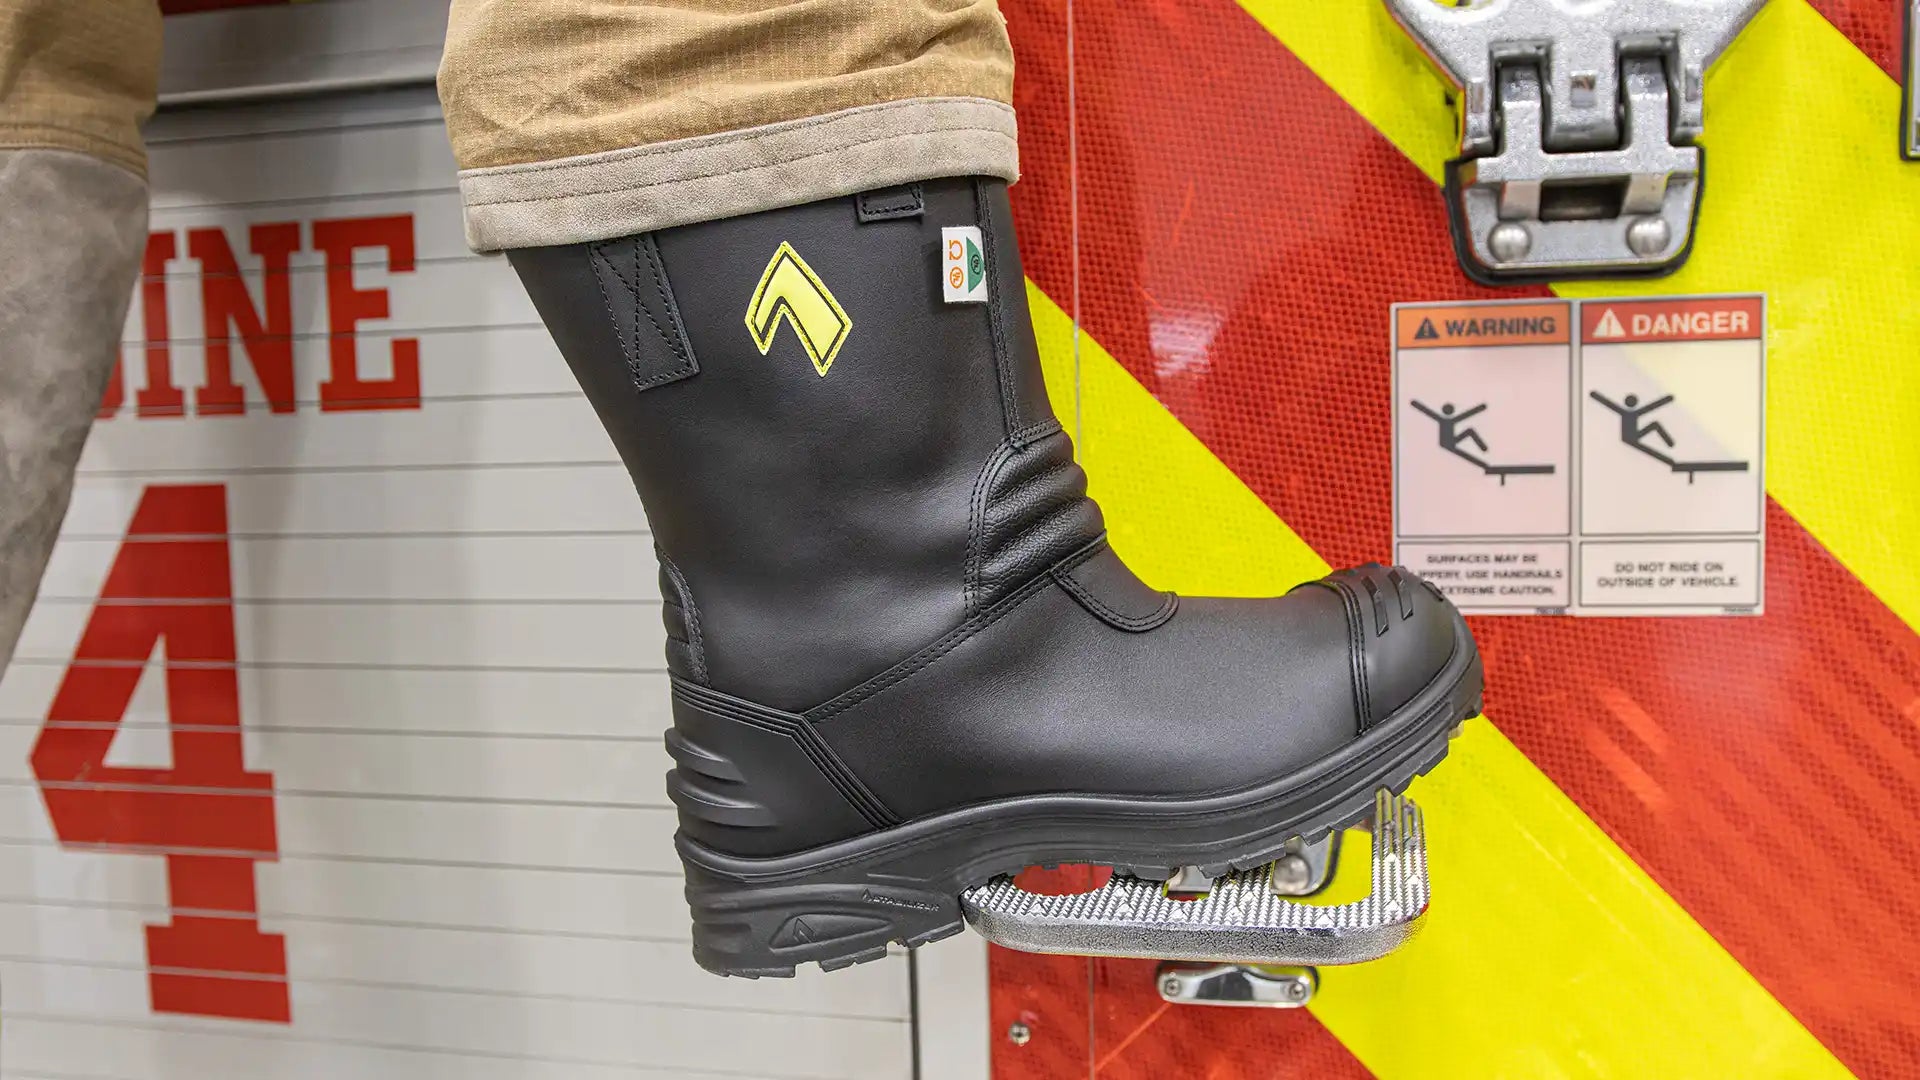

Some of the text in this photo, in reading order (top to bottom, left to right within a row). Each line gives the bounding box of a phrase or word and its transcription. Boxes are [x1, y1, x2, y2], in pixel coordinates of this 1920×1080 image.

[95, 213, 421, 420] INE
[1632, 310, 1749, 337] DANGER
[1445, 316, 1556, 337] WARNING
[1427, 554, 1538, 564] SURFACES MAY BE
[1615, 561, 1723, 574] DO NOT RIDE ON
[1466, 570, 1490, 579] USE
[1493, 569, 1563, 579] HANDRAILS
[1598, 576, 1738, 588] OUTSIDE OF VEHICLE.
[28, 483, 292, 1024] 4
